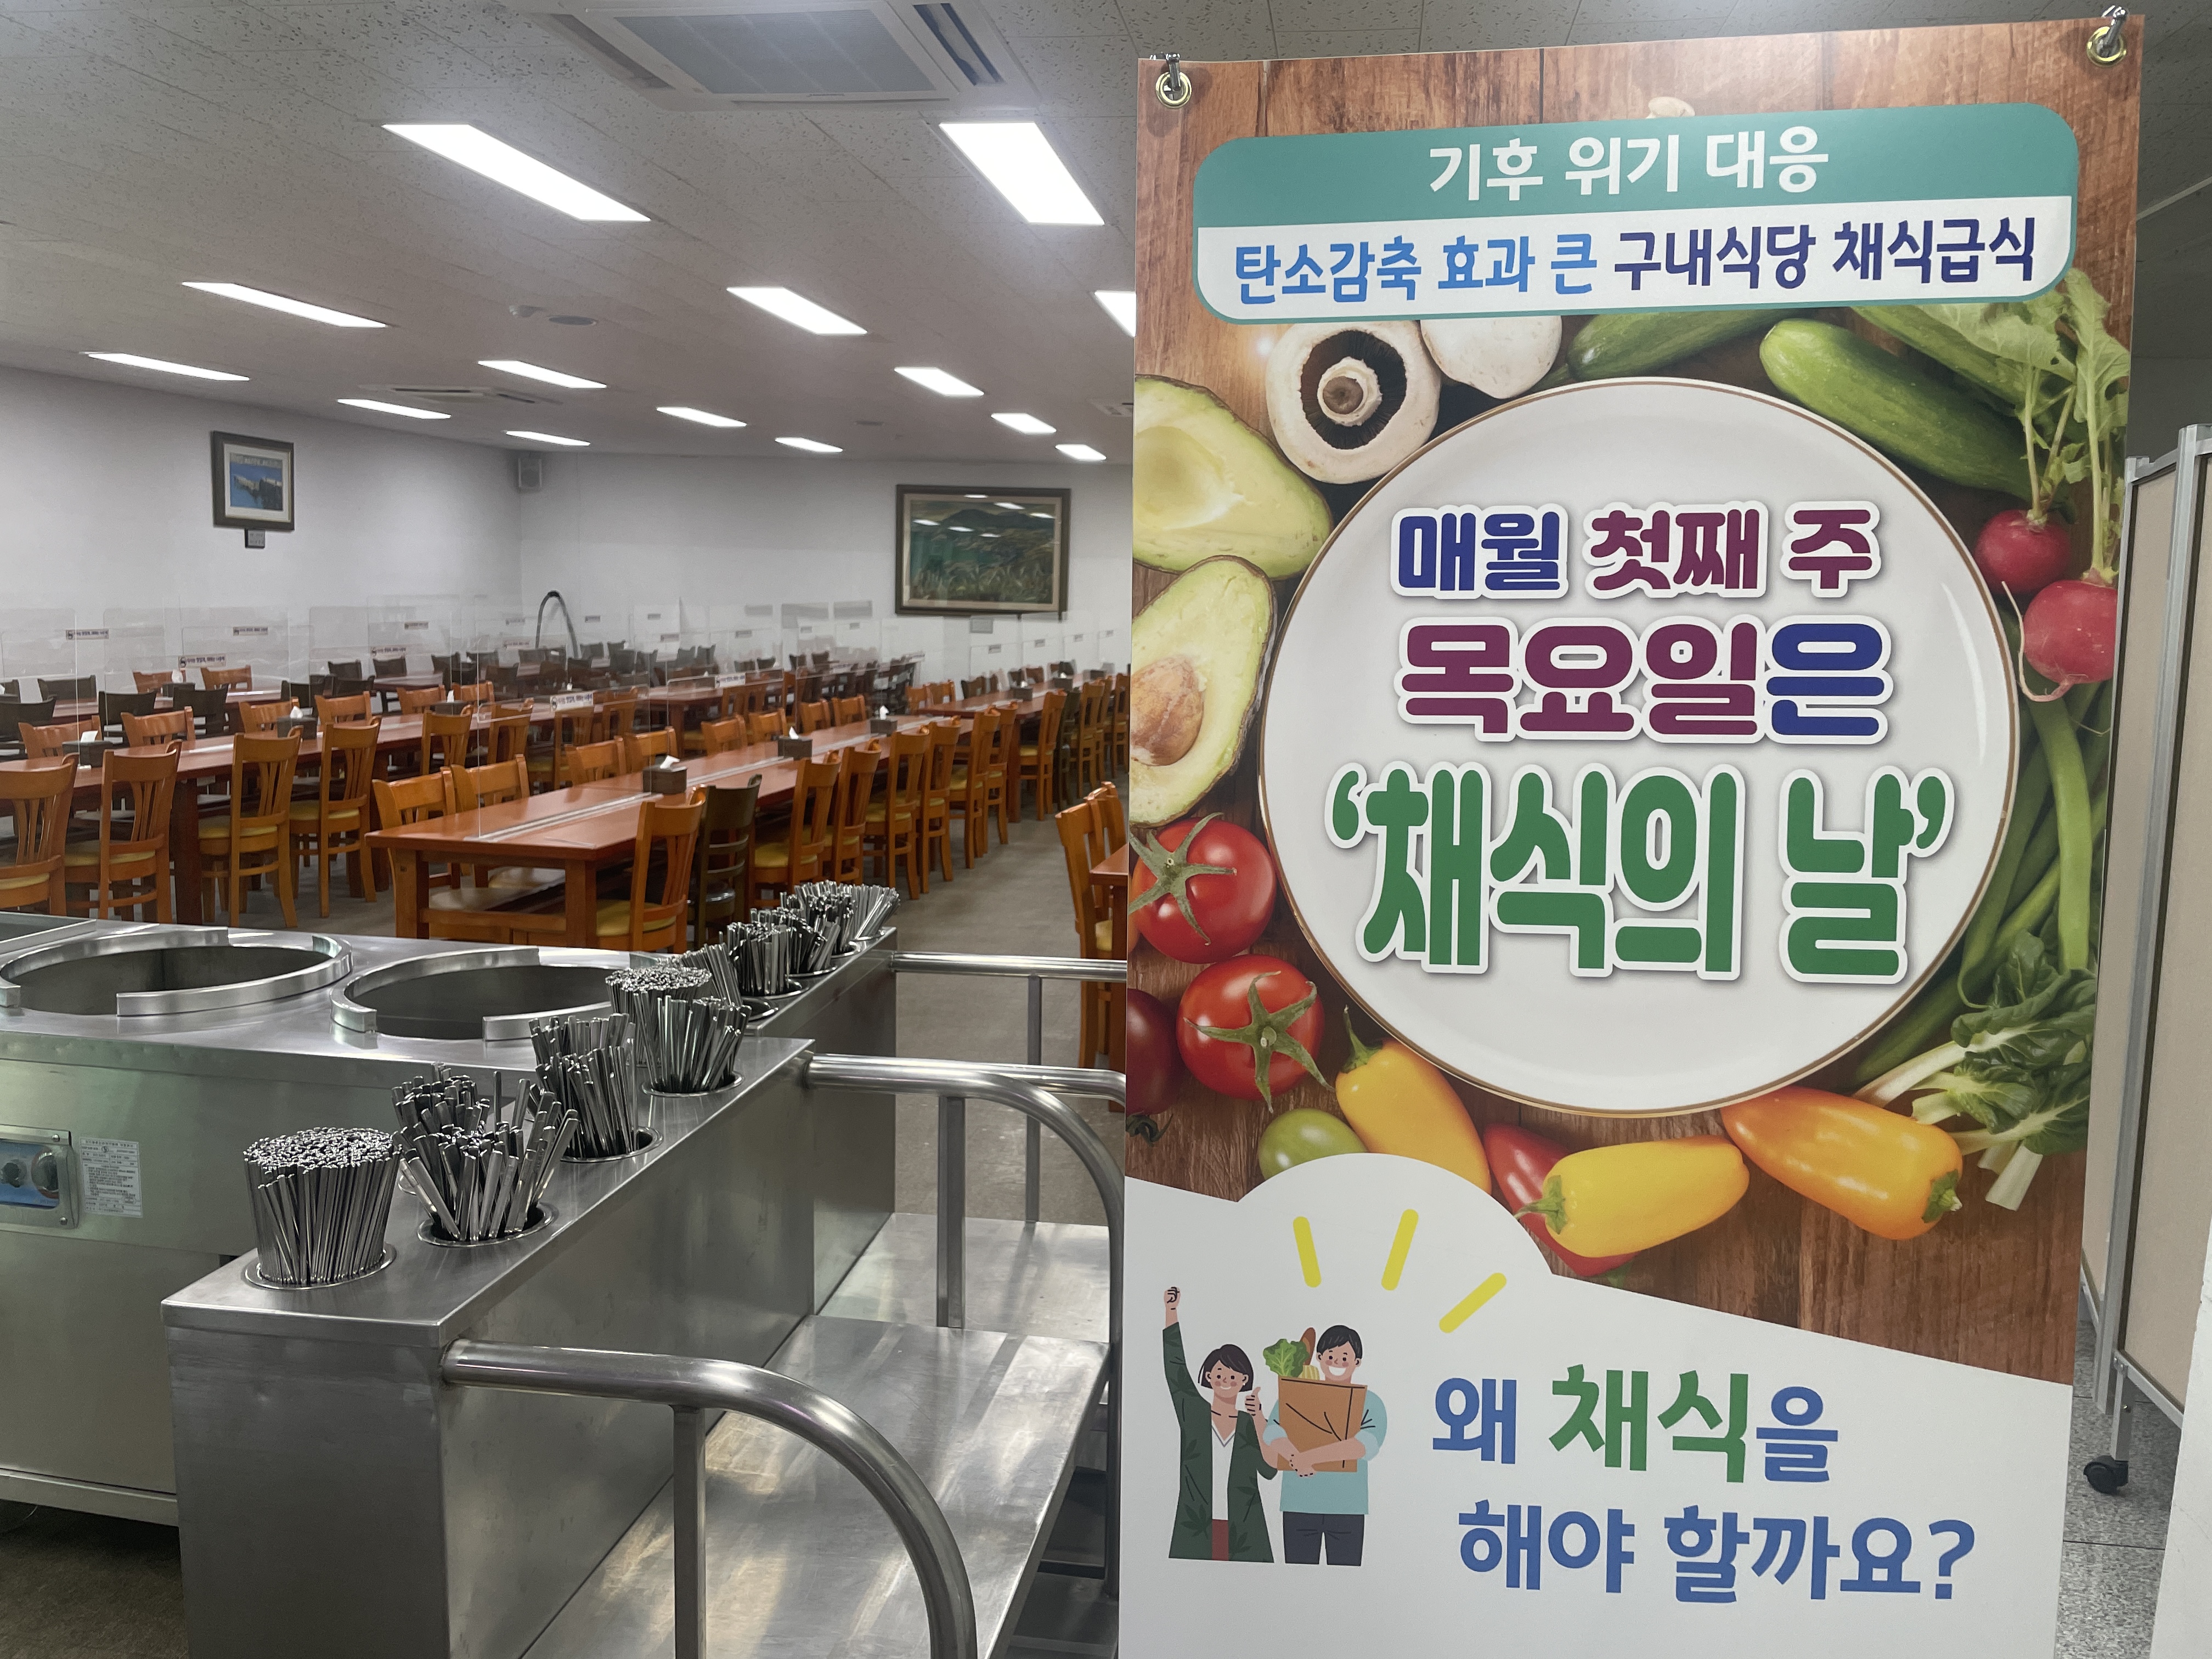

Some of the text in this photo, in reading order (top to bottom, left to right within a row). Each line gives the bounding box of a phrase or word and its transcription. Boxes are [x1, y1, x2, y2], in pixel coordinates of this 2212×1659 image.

[1429, 126, 1829, 201] 기후 위기 대응
[1235, 217, 2035, 305] 탄소감축 효과 큰 구내식당 채식급식
[1398, 508, 1874, 592] 매월 첫째 주
[1401, 622, 1886, 737] 목요일은
[1432, 1363, 1838, 1483] 왜 채식을
[1458, 1499, 1976, 1604] 해야 할까요?
